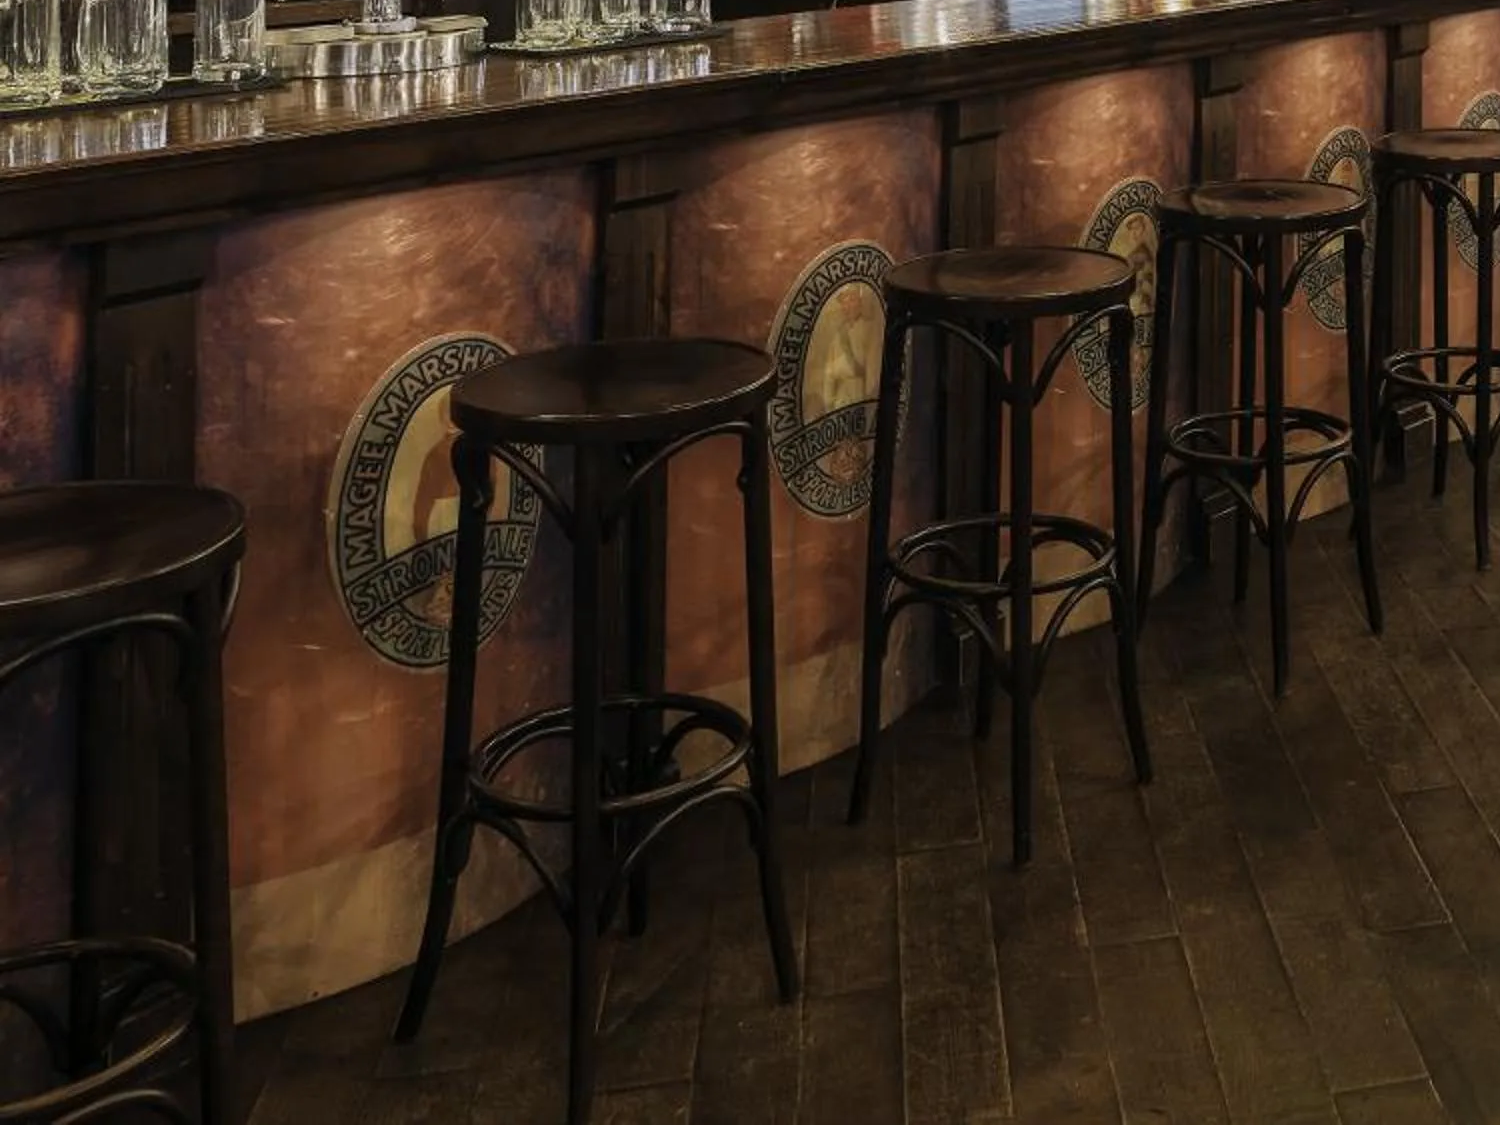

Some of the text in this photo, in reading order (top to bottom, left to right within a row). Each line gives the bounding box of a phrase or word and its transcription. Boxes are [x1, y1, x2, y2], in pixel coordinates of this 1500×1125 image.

[779, 409, 866, 473] STRONG
[351, 525, 536, 621] STRON ALE
[377, 610, 434, 658] SPORT
